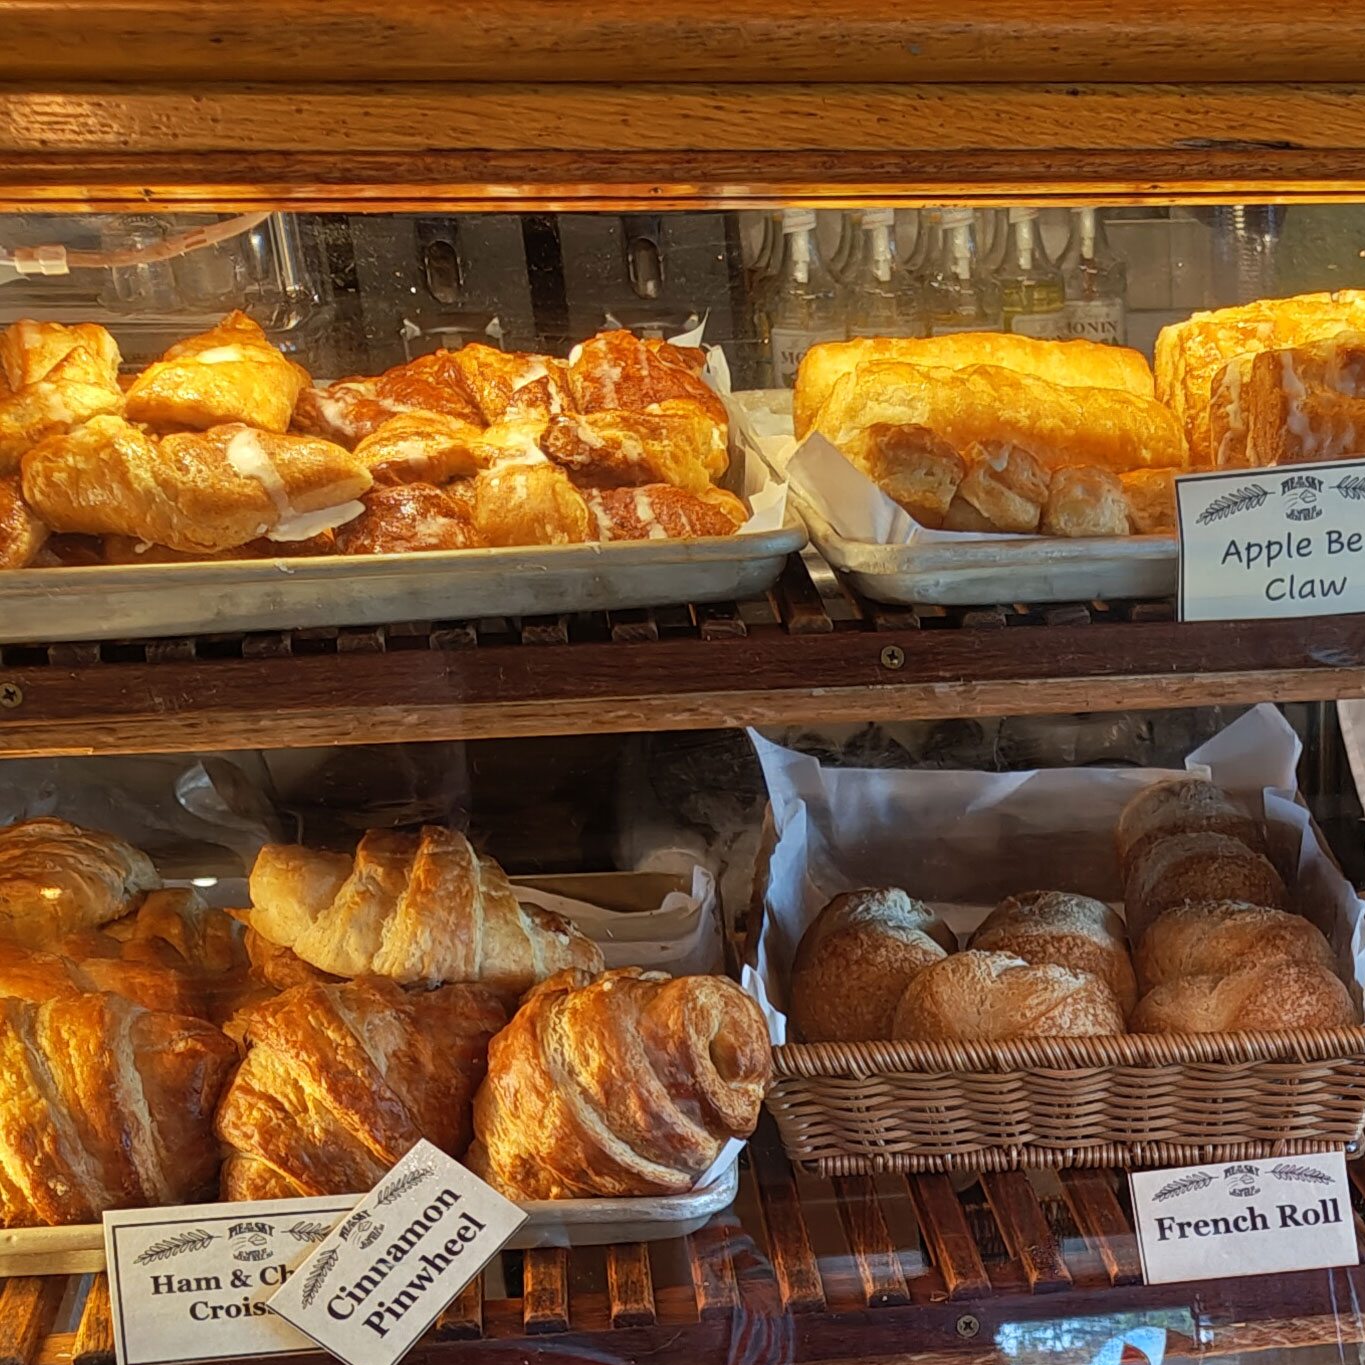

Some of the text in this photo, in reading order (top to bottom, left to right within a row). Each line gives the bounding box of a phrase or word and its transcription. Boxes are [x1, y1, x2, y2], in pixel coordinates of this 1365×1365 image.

[1066, 320, 1117, 334] ONIN
[1221, 532, 1313, 570] Apple
[1265, 574, 1347, 601] Claw
[1155, 1198, 1343, 1241] French Roll
[327, 1187, 462, 1322] Cinnamon
[150, 1273, 221, 1295] Ham
[230, 1269, 252, 1287] &
[362, 1212, 487, 1339] Pinwheel
[189, 1296, 276, 1321] Crois
